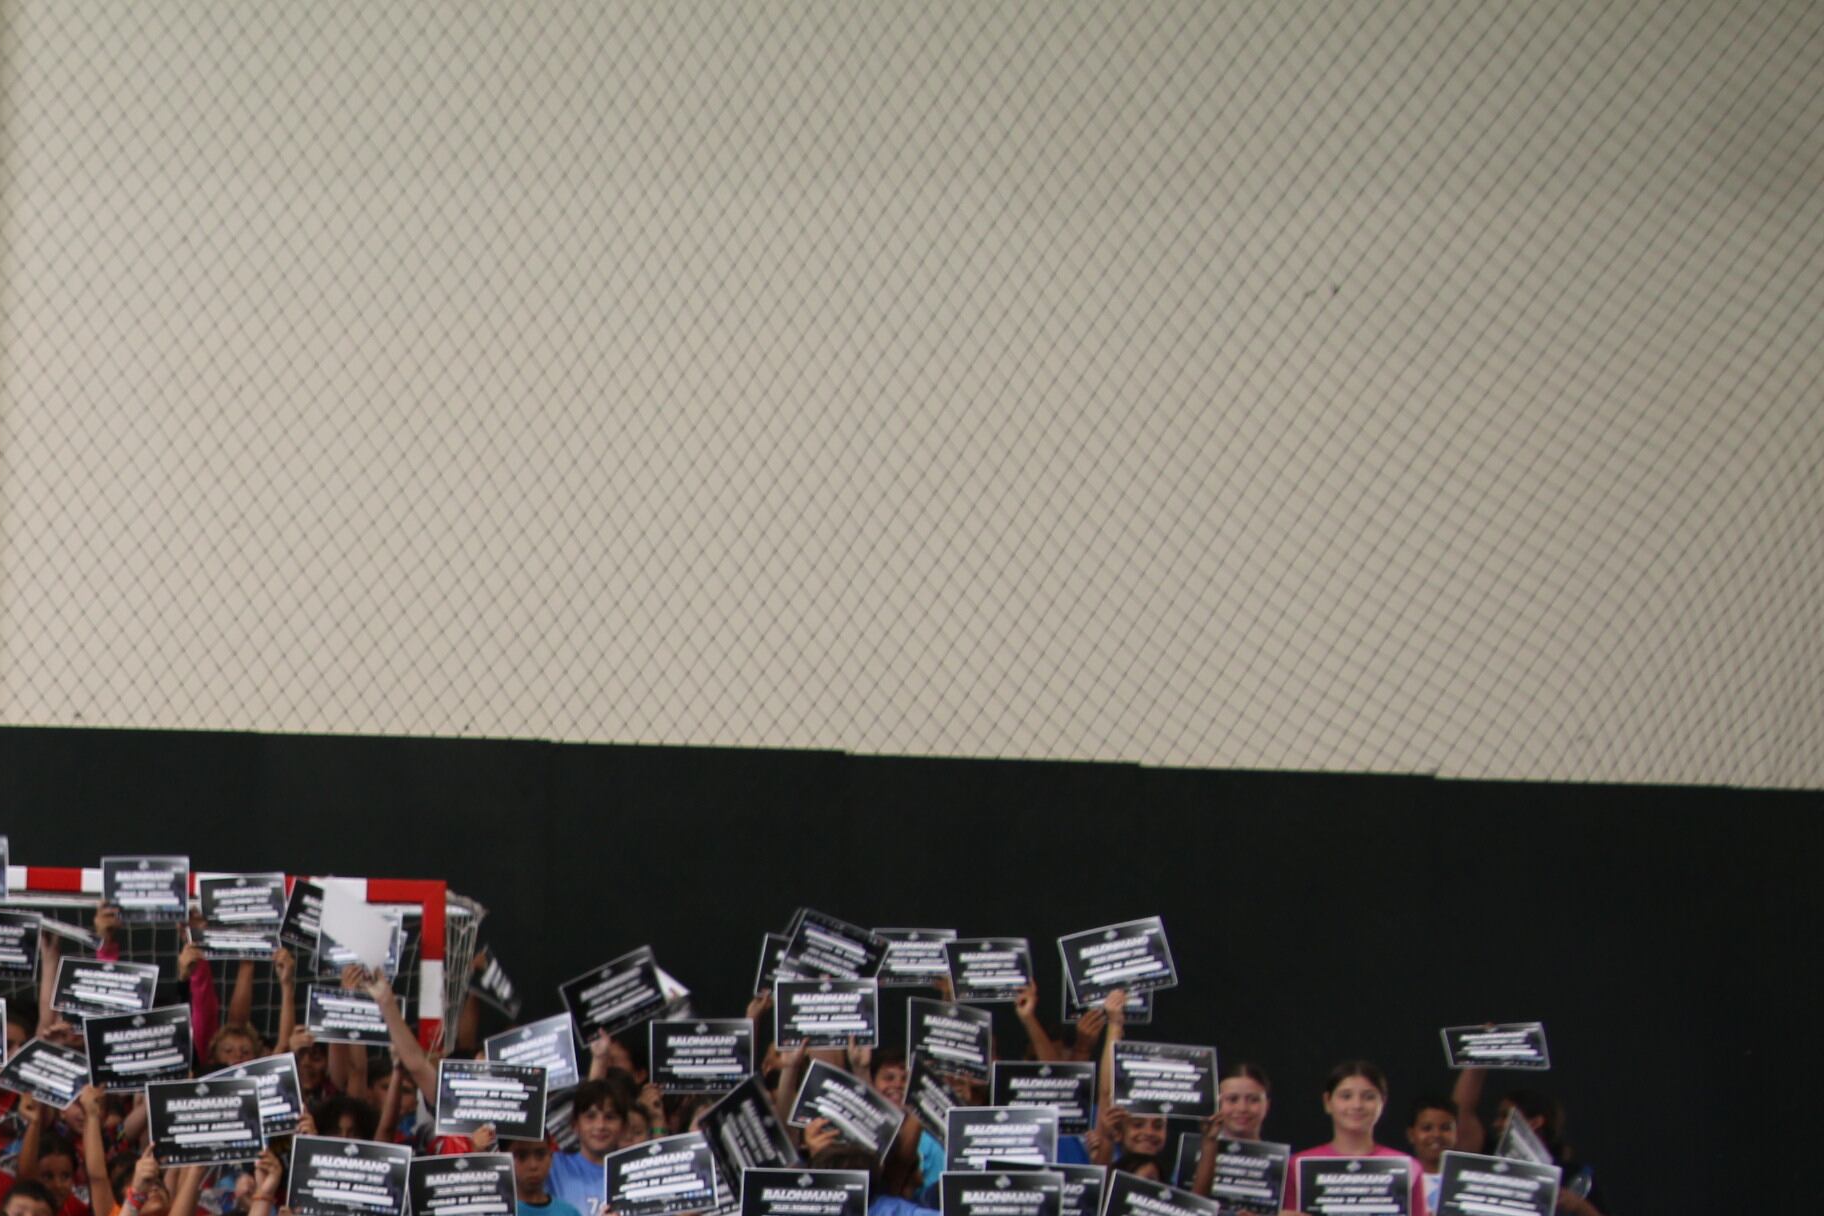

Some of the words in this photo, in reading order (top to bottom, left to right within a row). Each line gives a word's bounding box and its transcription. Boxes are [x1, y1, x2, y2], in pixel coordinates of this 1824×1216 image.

[167, 1095, 241, 1112] BALONMANO
[452, 1108, 526, 1121] BALONMANO
[310, 1154, 391, 1173] BALONMANO
[621, 1147, 695, 1173] BALONMANO
[762, 1188, 848, 1202] BALONMANO
[962, 1190, 1045, 1203] BALONMANO
